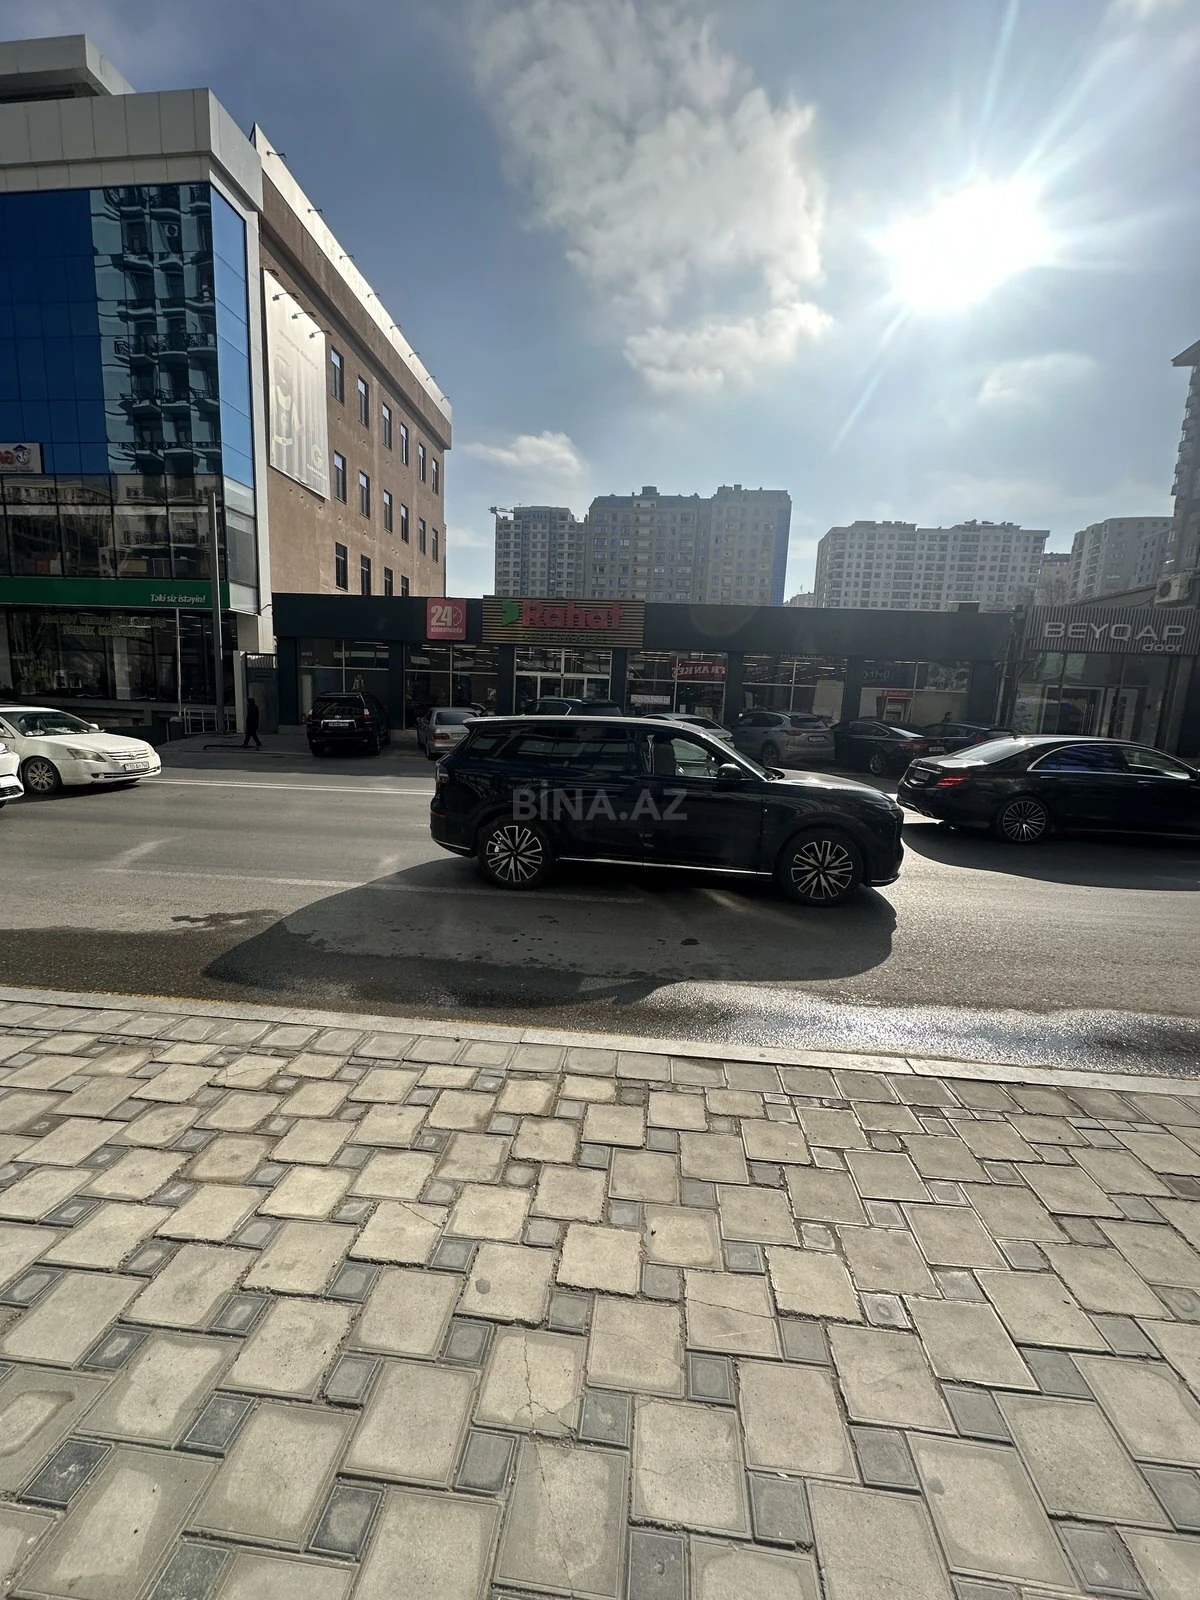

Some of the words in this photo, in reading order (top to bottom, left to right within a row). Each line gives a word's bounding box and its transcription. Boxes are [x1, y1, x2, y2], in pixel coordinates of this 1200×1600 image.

[431, 606, 453, 626] 24
[521, 599, 624, 630] Rahat
[1044, 622, 1186, 641] BEYQAP
[1143, 643, 1183, 652] door
